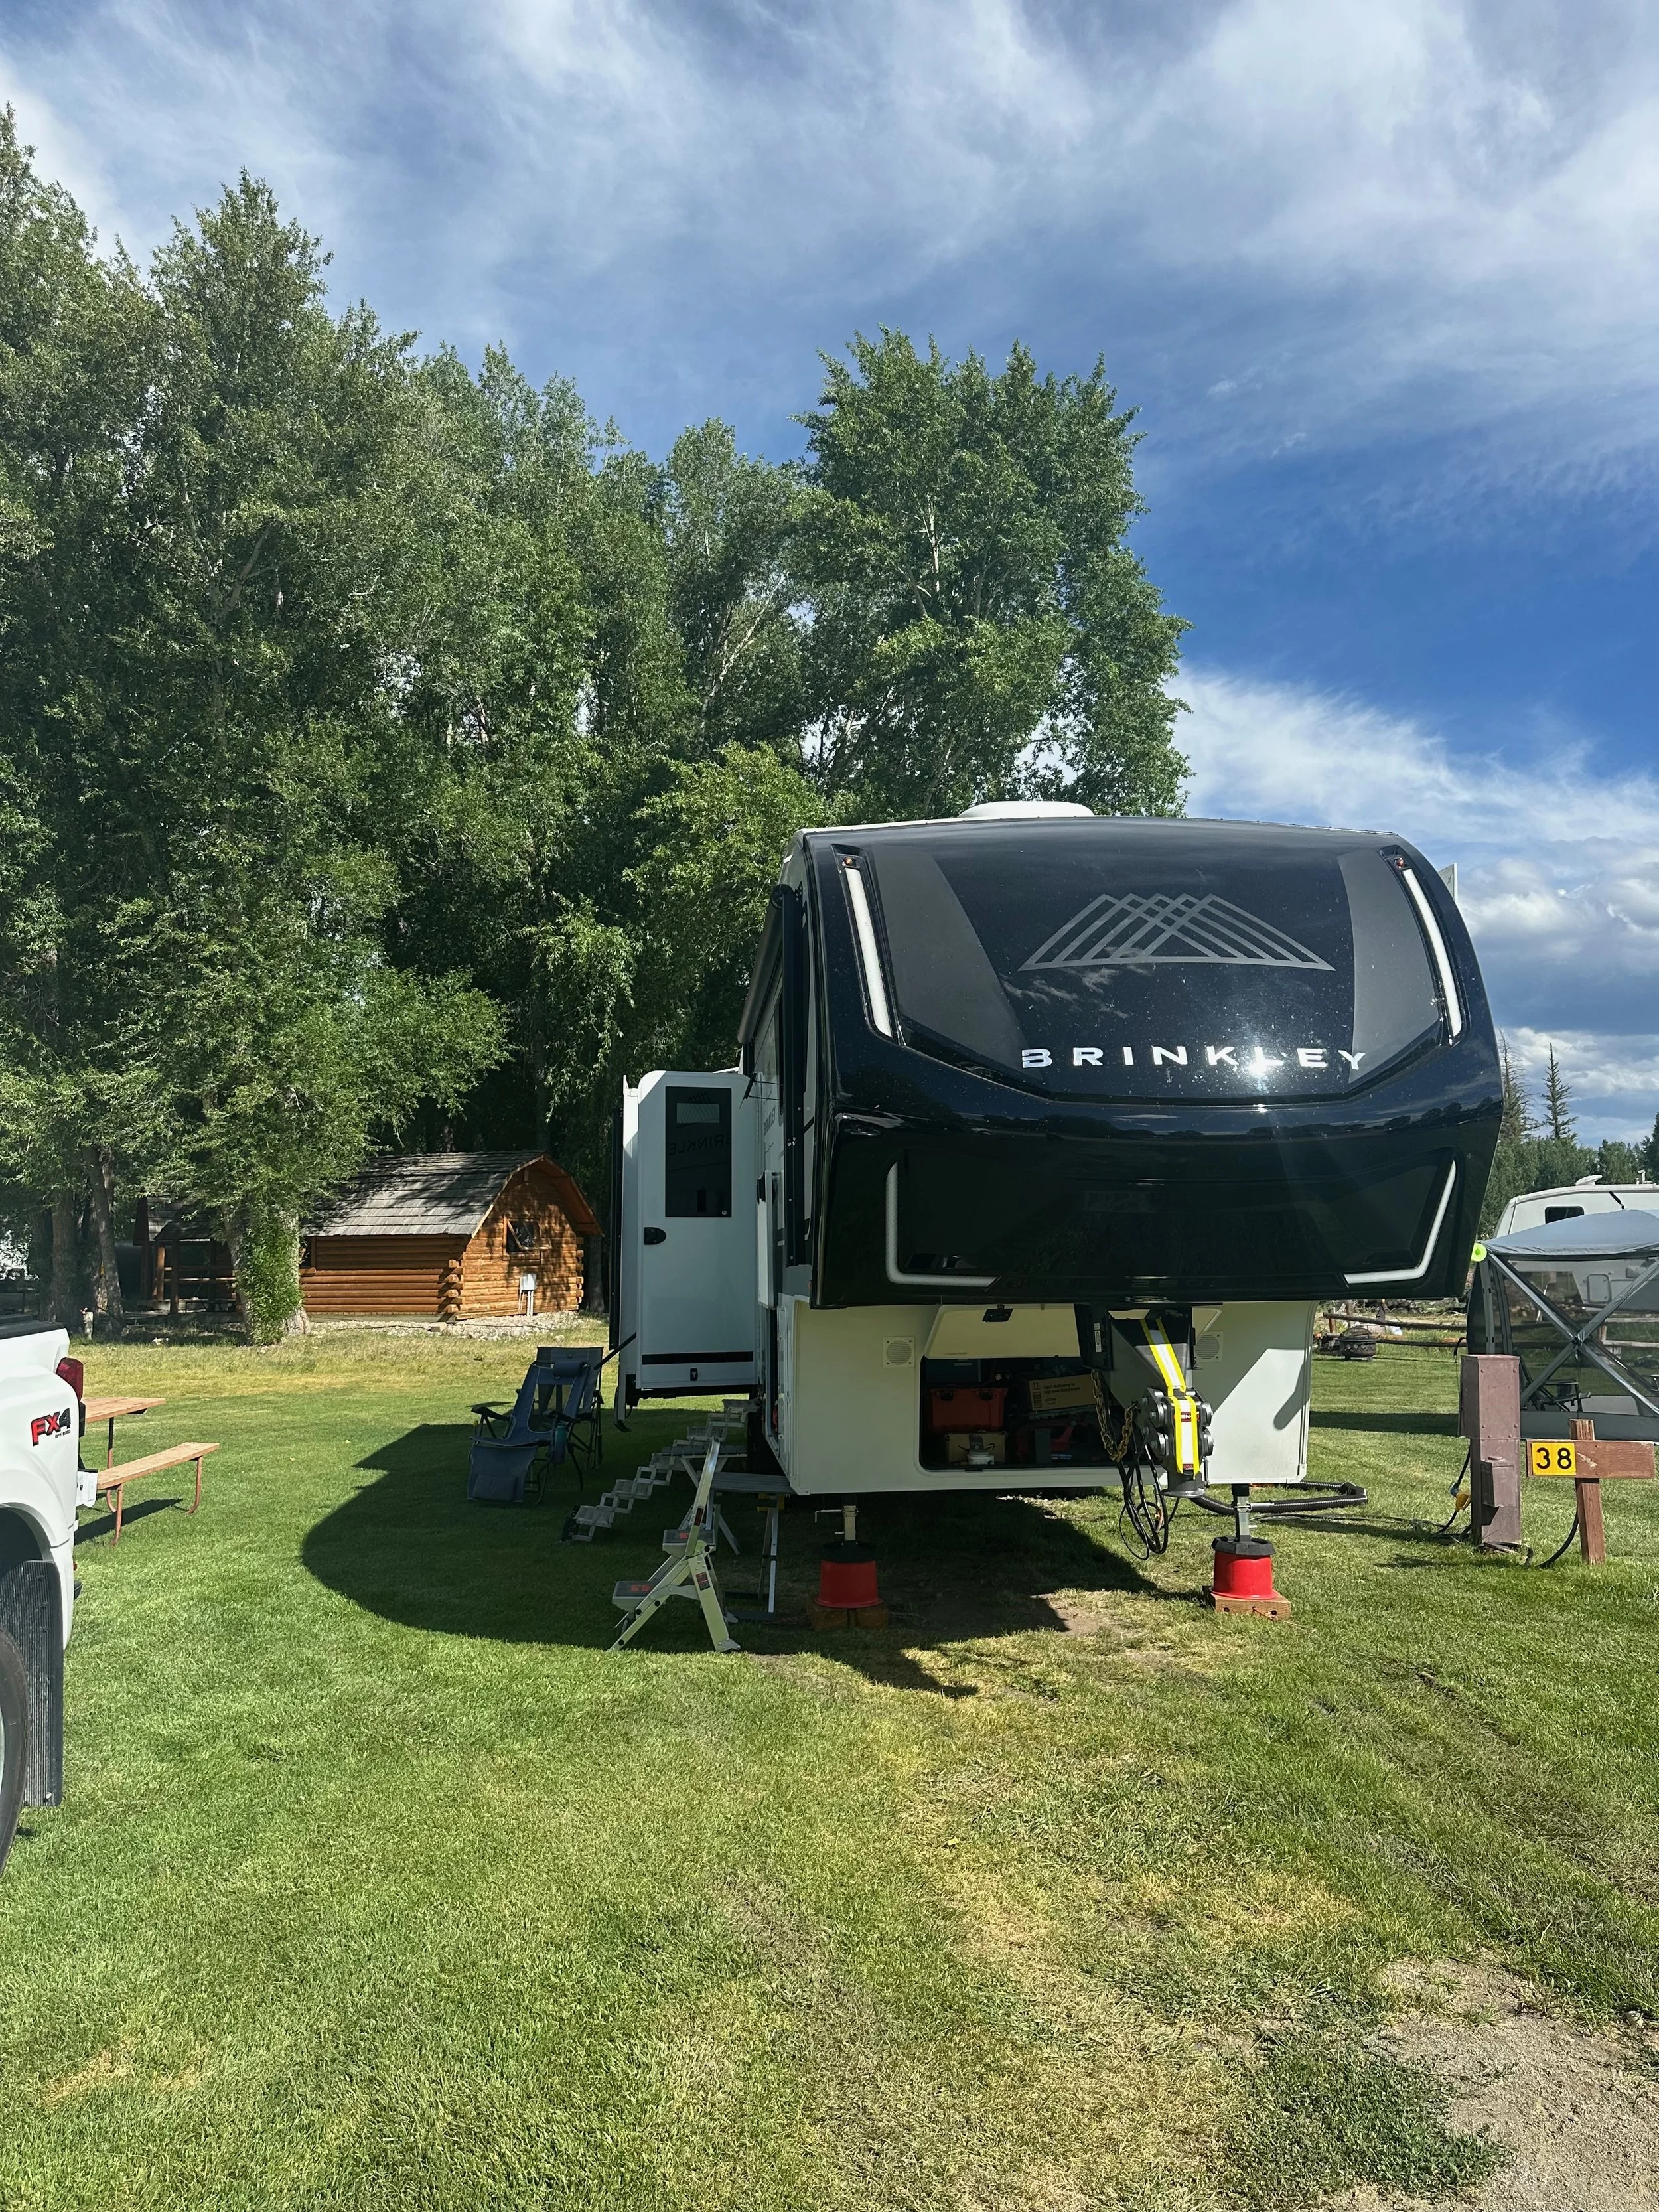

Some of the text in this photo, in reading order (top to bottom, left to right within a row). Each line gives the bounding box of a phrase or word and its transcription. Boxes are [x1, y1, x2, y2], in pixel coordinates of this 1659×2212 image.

[1021, 1045, 1366, 1070] BRINKLEY
[31, 1408, 71, 1447] FX4
[1536, 1447, 1573, 1471] 38
